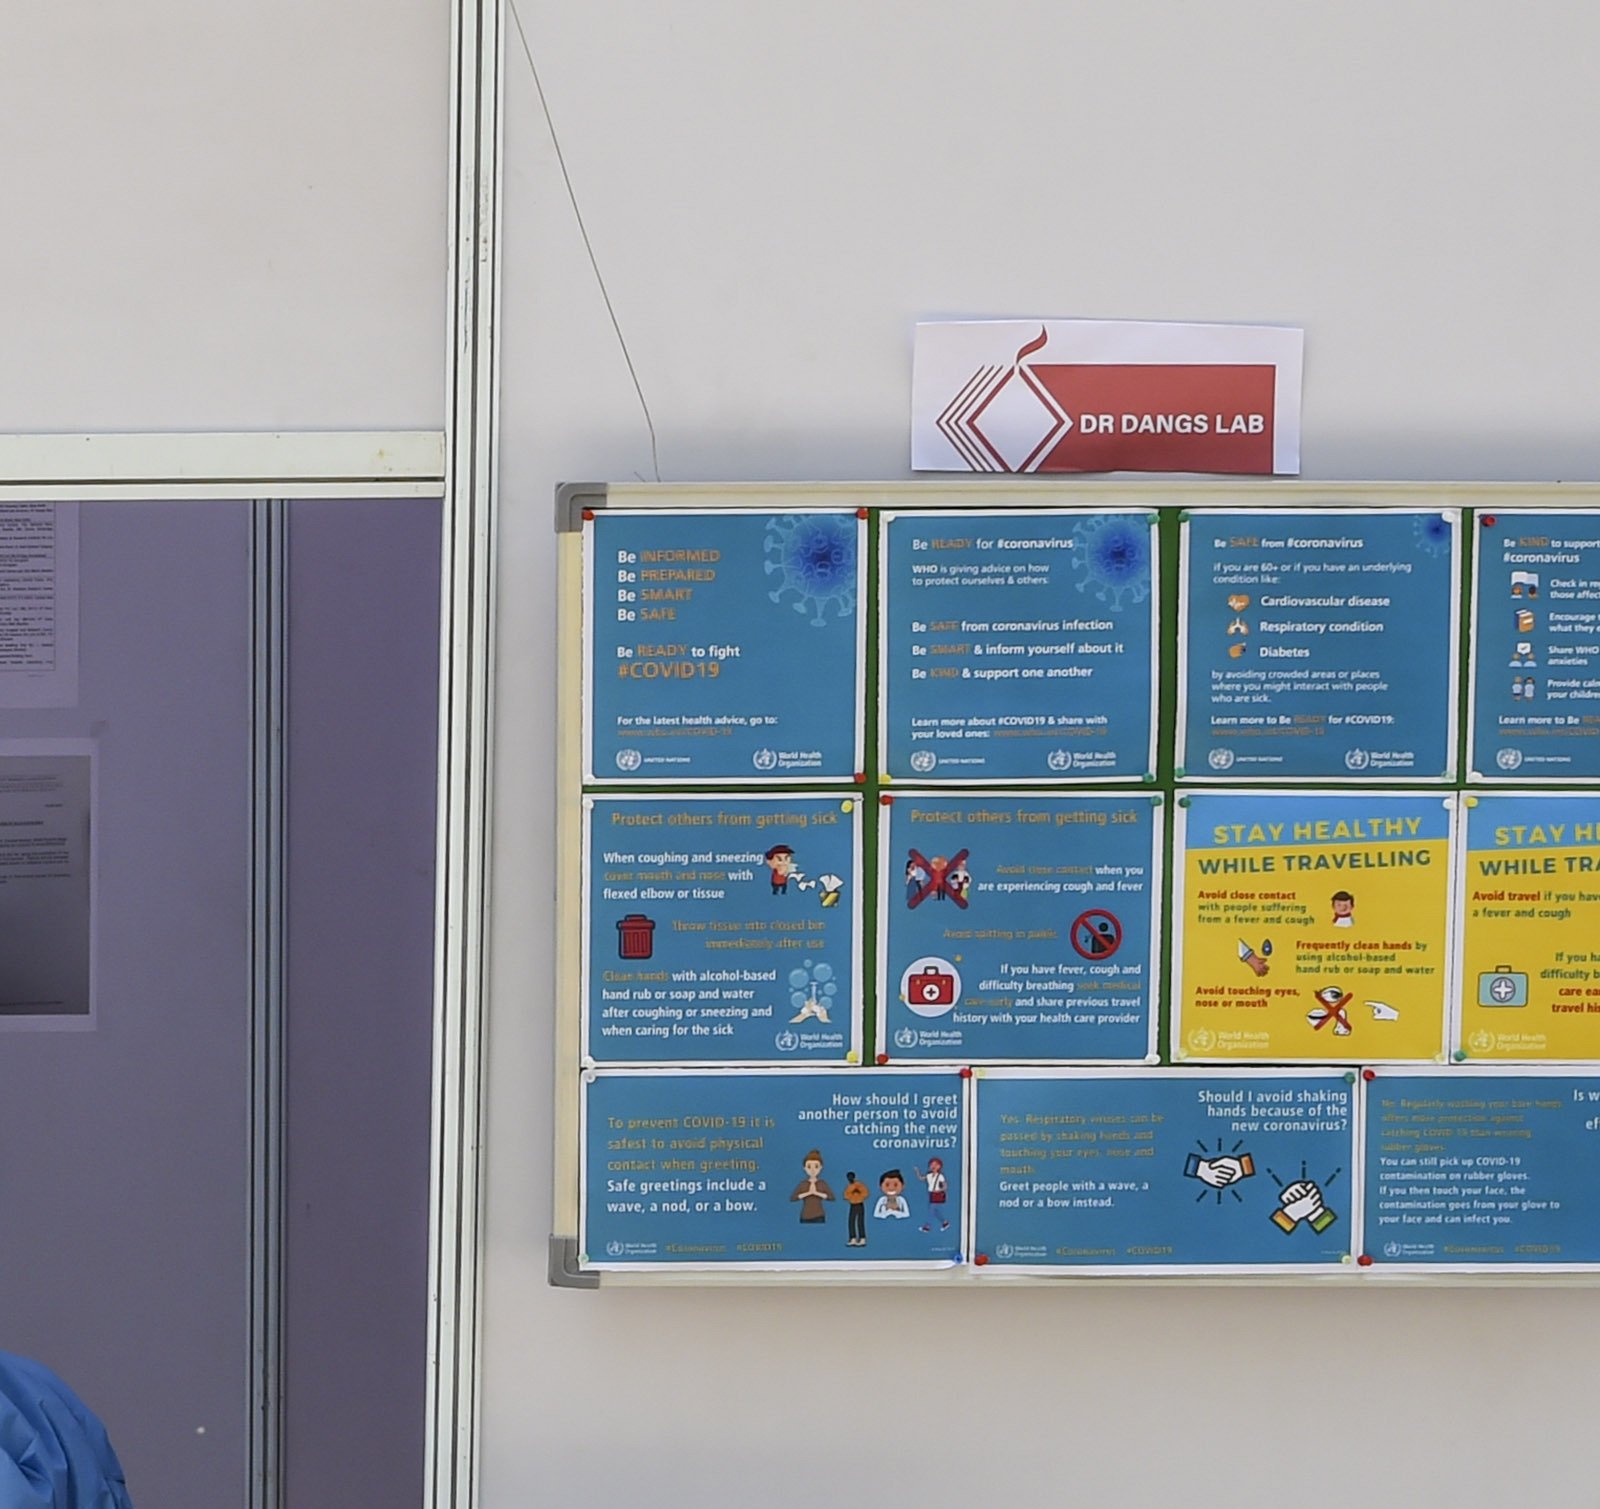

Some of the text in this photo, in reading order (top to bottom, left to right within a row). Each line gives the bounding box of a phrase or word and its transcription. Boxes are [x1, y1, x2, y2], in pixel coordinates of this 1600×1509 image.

[1080, 414, 1264, 434] DR DANGS LAB
[912, 539, 928, 550] Be
[976, 538, 994, 549] for
[997, 537, 1074, 550] #coronavirus
[1214, 539, 1227, 548] Be
[1261, 538, 1284, 548] from
[1287, 537, 1363, 548] #coronavirus
[618, 550, 720, 563] Be INFORMED
[1503, 552, 1580, 563] #coronavirus
[618, 569, 715, 583] Be PREPARED
[618, 589, 691, 602] Be SMART
[1261, 595, 1390, 606] Cardiovascular disease
[618, 608, 675, 621] Be SAFE
[912, 622, 927, 632] Be
[961, 621, 989, 631] from
[992, 620, 1059, 631] coronavirus
[1062, 620, 1113, 630] infection
[1260, 621, 1384, 634] Respiratory condition
[617, 646, 633, 658] Be
[691, 647, 706, 657] to
[709, 645, 741, 660] fight
[1260, 646, 1310, 657] Diabetes
[619, 662, 720, 678] #COVID19
[617, 715, 778, 726] For the latest health advice, go to:
[612, 812, 837, 829] Protect others from getting sick
[1214, 817, 1420, 845] STAY HEALTHY
[1496, 826, 1564, 846] STAY
[603, 851, 764, 866] When coughing and sneezing
[1198, 849, 1431, 875] WHILE TRAVELLING
[1479, 858, 1556, 876] WHILE
[603, 887, 725, 900] flexed elbow or tissue
[1197, 890, 1296, 900] Avoid close contact
[1472, 890, 1541, 901] Avoid travel
[602, 988, 755, 1002] hand rub or soap and water
[833, 1092, 958, 1109] How should I greet
[1198, 1089, 1347, 1105] Should I avoid shaking
[798, 1106, 957, 1123] another person to avoid
[1208, 1103, 1347, 1117] hands because of the
[844, 1121, 958, 1138] catching the new
[1231, 1118, 1347, 1132] new coronavirus?
[873, 1136, 957, 1148] coronavirus?
[607, 1178, 766, 1195] Safe greetings include a
[607, 1199, 757, 1213] wave, a nod, or a bow.
